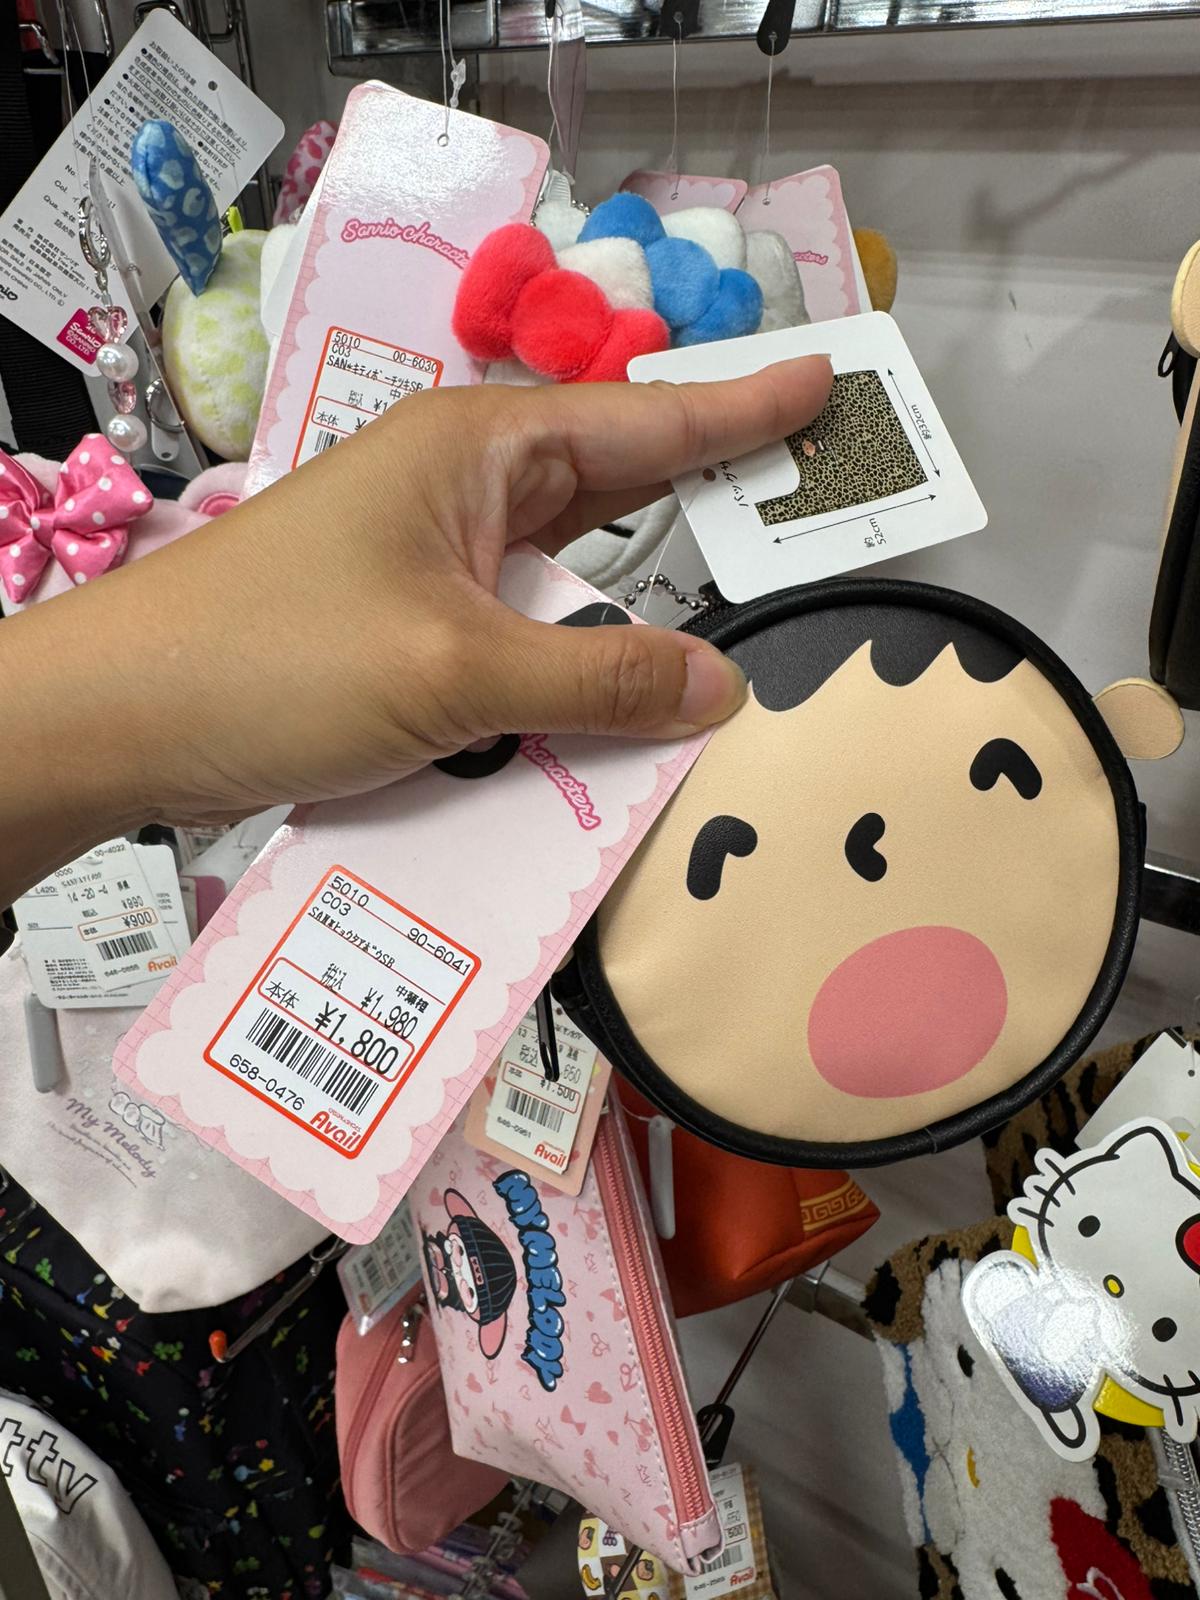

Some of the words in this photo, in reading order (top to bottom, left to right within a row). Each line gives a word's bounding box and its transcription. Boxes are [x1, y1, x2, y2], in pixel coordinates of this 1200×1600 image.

[341, 218, 399, 243] Sanrio
[330, 343, 351, 357] C03
[333, 331, 361, 349] 5010
[316, 410, 339, 425] 本体
[320, 890, 352, 916] C03
[122, 910, 152, 928] ¥900
[329, 876, 370, 908] 5010
[405, 926, 471, 975] 90-6041
[147, 955, 177, 972] Avail
[320, 963, 348, 993] 税込
[358, 988, 418, 1039] ¥1,980
[264, 978, 300, 1010] 本体
[310, 1002, 400, 1075] ¥1,800
[227, 1053, 306, 1111] 658-0476
[309, 1108, 360, 1150] Avail
[534, 1143, 565, 1166] Avail
